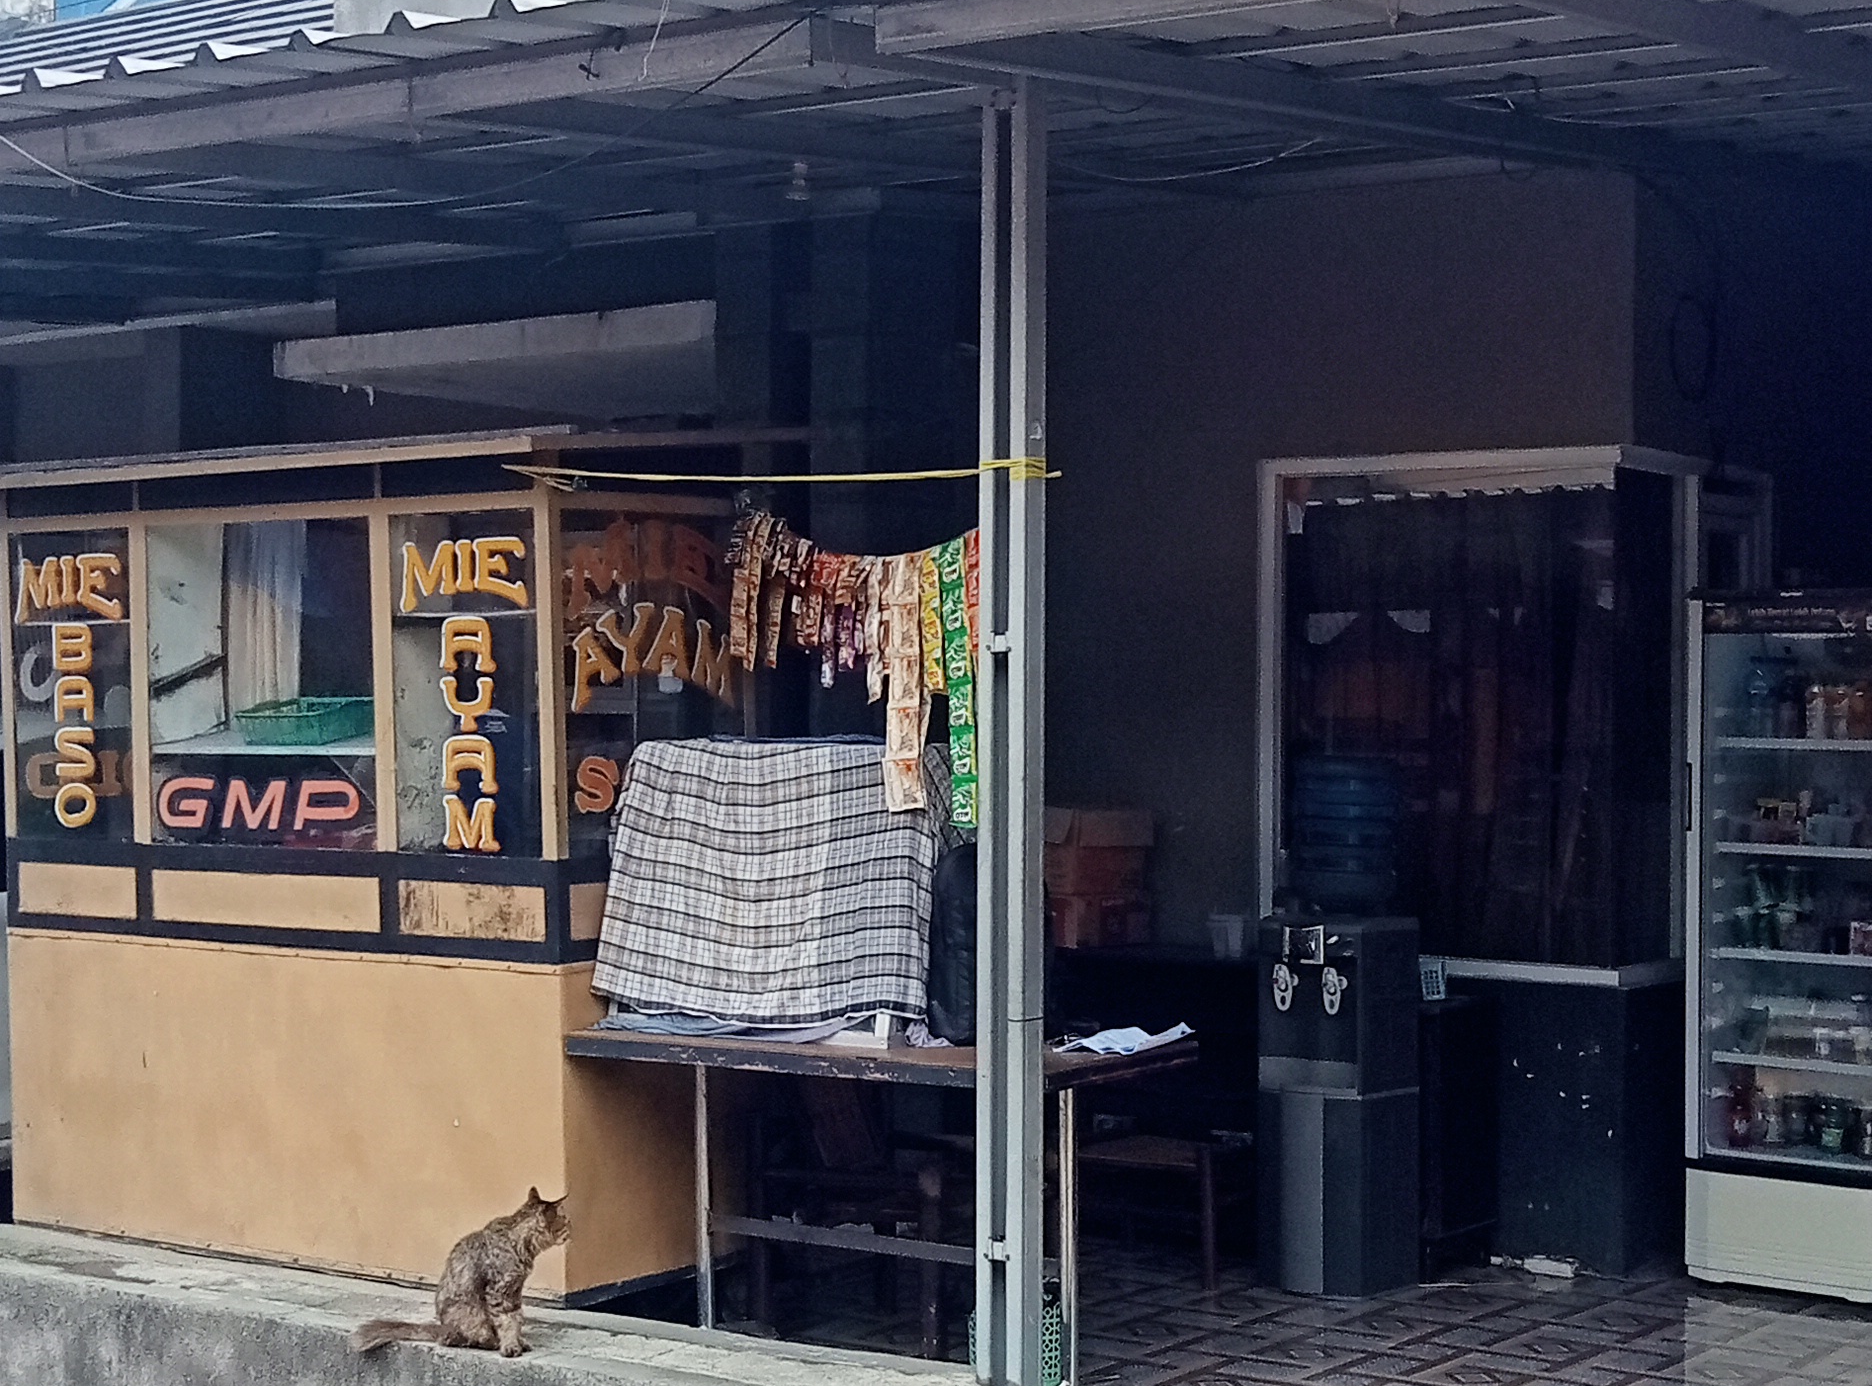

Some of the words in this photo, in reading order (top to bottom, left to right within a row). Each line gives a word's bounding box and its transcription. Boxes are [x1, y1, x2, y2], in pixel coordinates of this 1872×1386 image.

[16, 553, 123, 623] MIE
[399, 537, 529, 613] MIE
[567, 519, 733, 619] MIE
[571, 603, 734, 713] AYAM
[52, 623, 97, 829] BASO
[440, 617, 502, 852] AYAM
[158, 777, 360, 830] GMP
